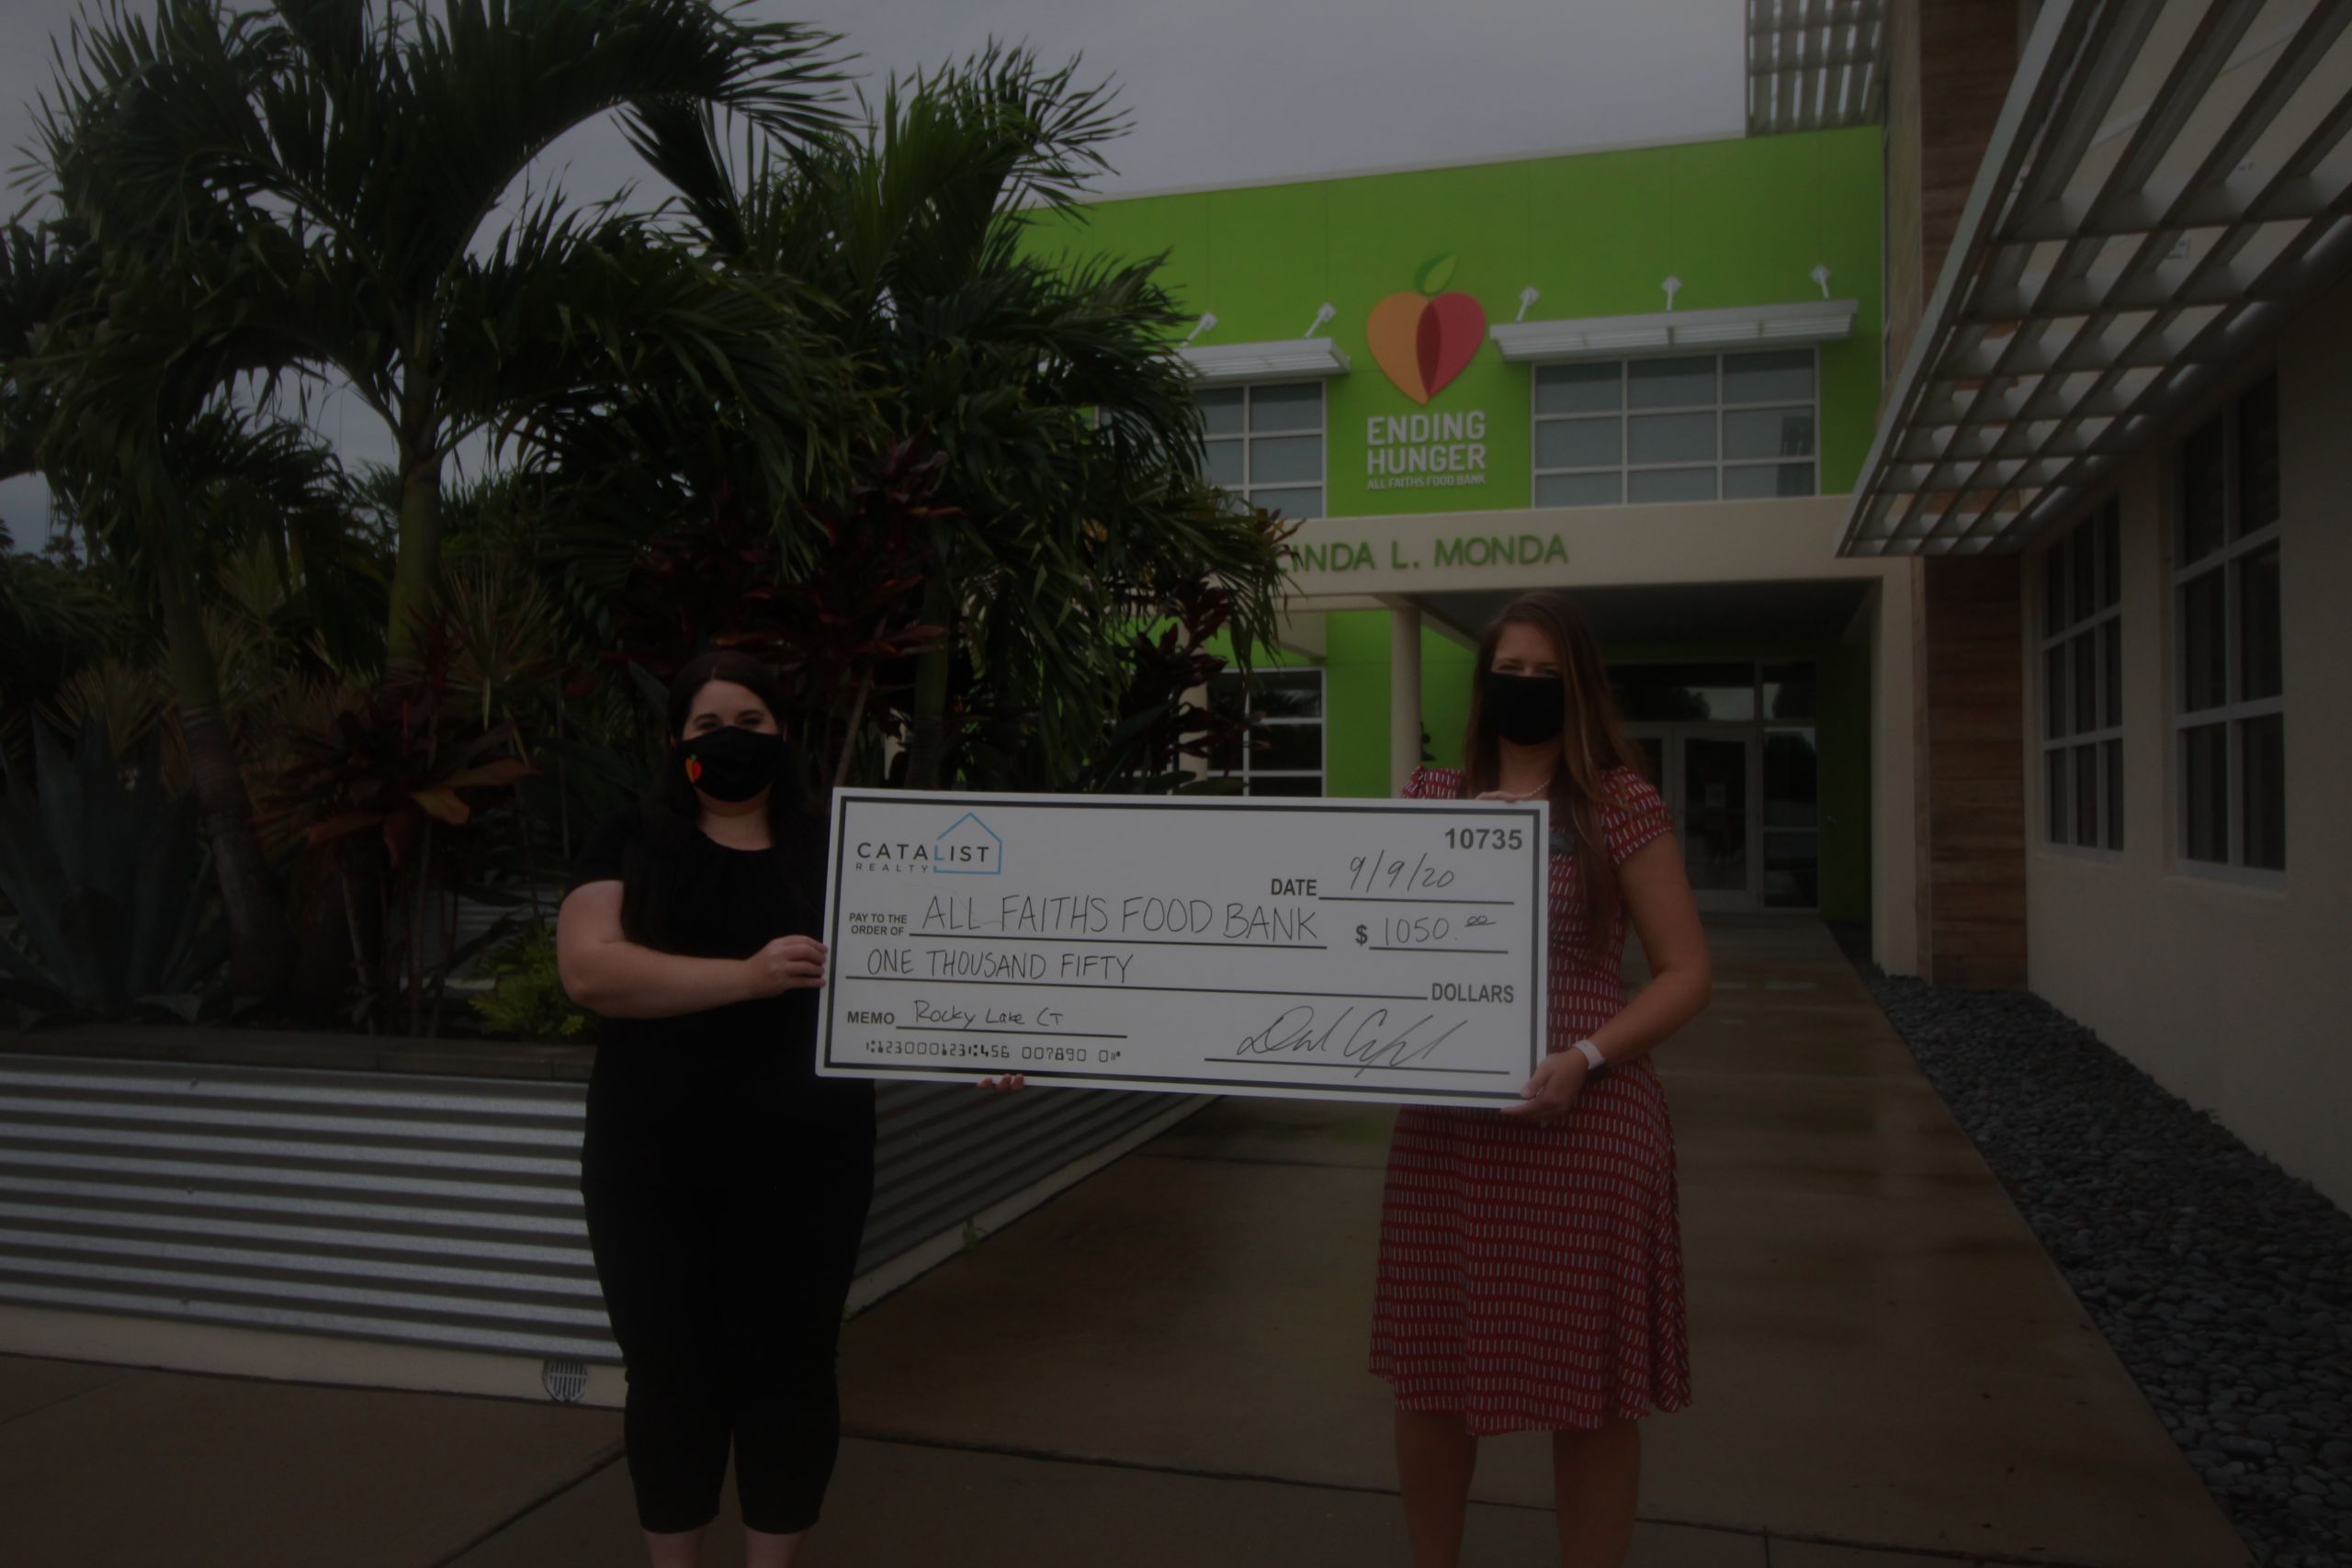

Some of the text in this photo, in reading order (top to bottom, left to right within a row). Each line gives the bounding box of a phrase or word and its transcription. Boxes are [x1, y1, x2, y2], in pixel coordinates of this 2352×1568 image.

[1367, 411, 1486, 446] ENDING
[1367, 443, 1486, 475] HUNGER
[1367, 473, 1486, 491] ALL FAITHS FOOD BANK
[1275, 533, 1569, 573] INDA L. MONDA
[1444, 828, 1522, 852] 10735
[856, 841, 989, 863] CATALIST
[855, 863, 928, 873] REALTY
[1349, 850, 1455, 893] 9/9/20
[1270, 878, 1317, 897] DATE
[849, 912, 908, 925] PAY TO THE
[922, 894, 1318, 942] ALL FAITHS FOOD BANK
[851, 925, 904, 936] ORDER OF
[1355, 924, 1368, 947] $
[867, 948, 1134, 984] ONE THOUSAND FIFTY
[1431, 982, 1514, 1004] DOLLARS
[847, 1010, 895, 1025] MEMO
[913, 999, 976, 1029] Rocky
[1022, 1046, 1086, 1062] 007890
